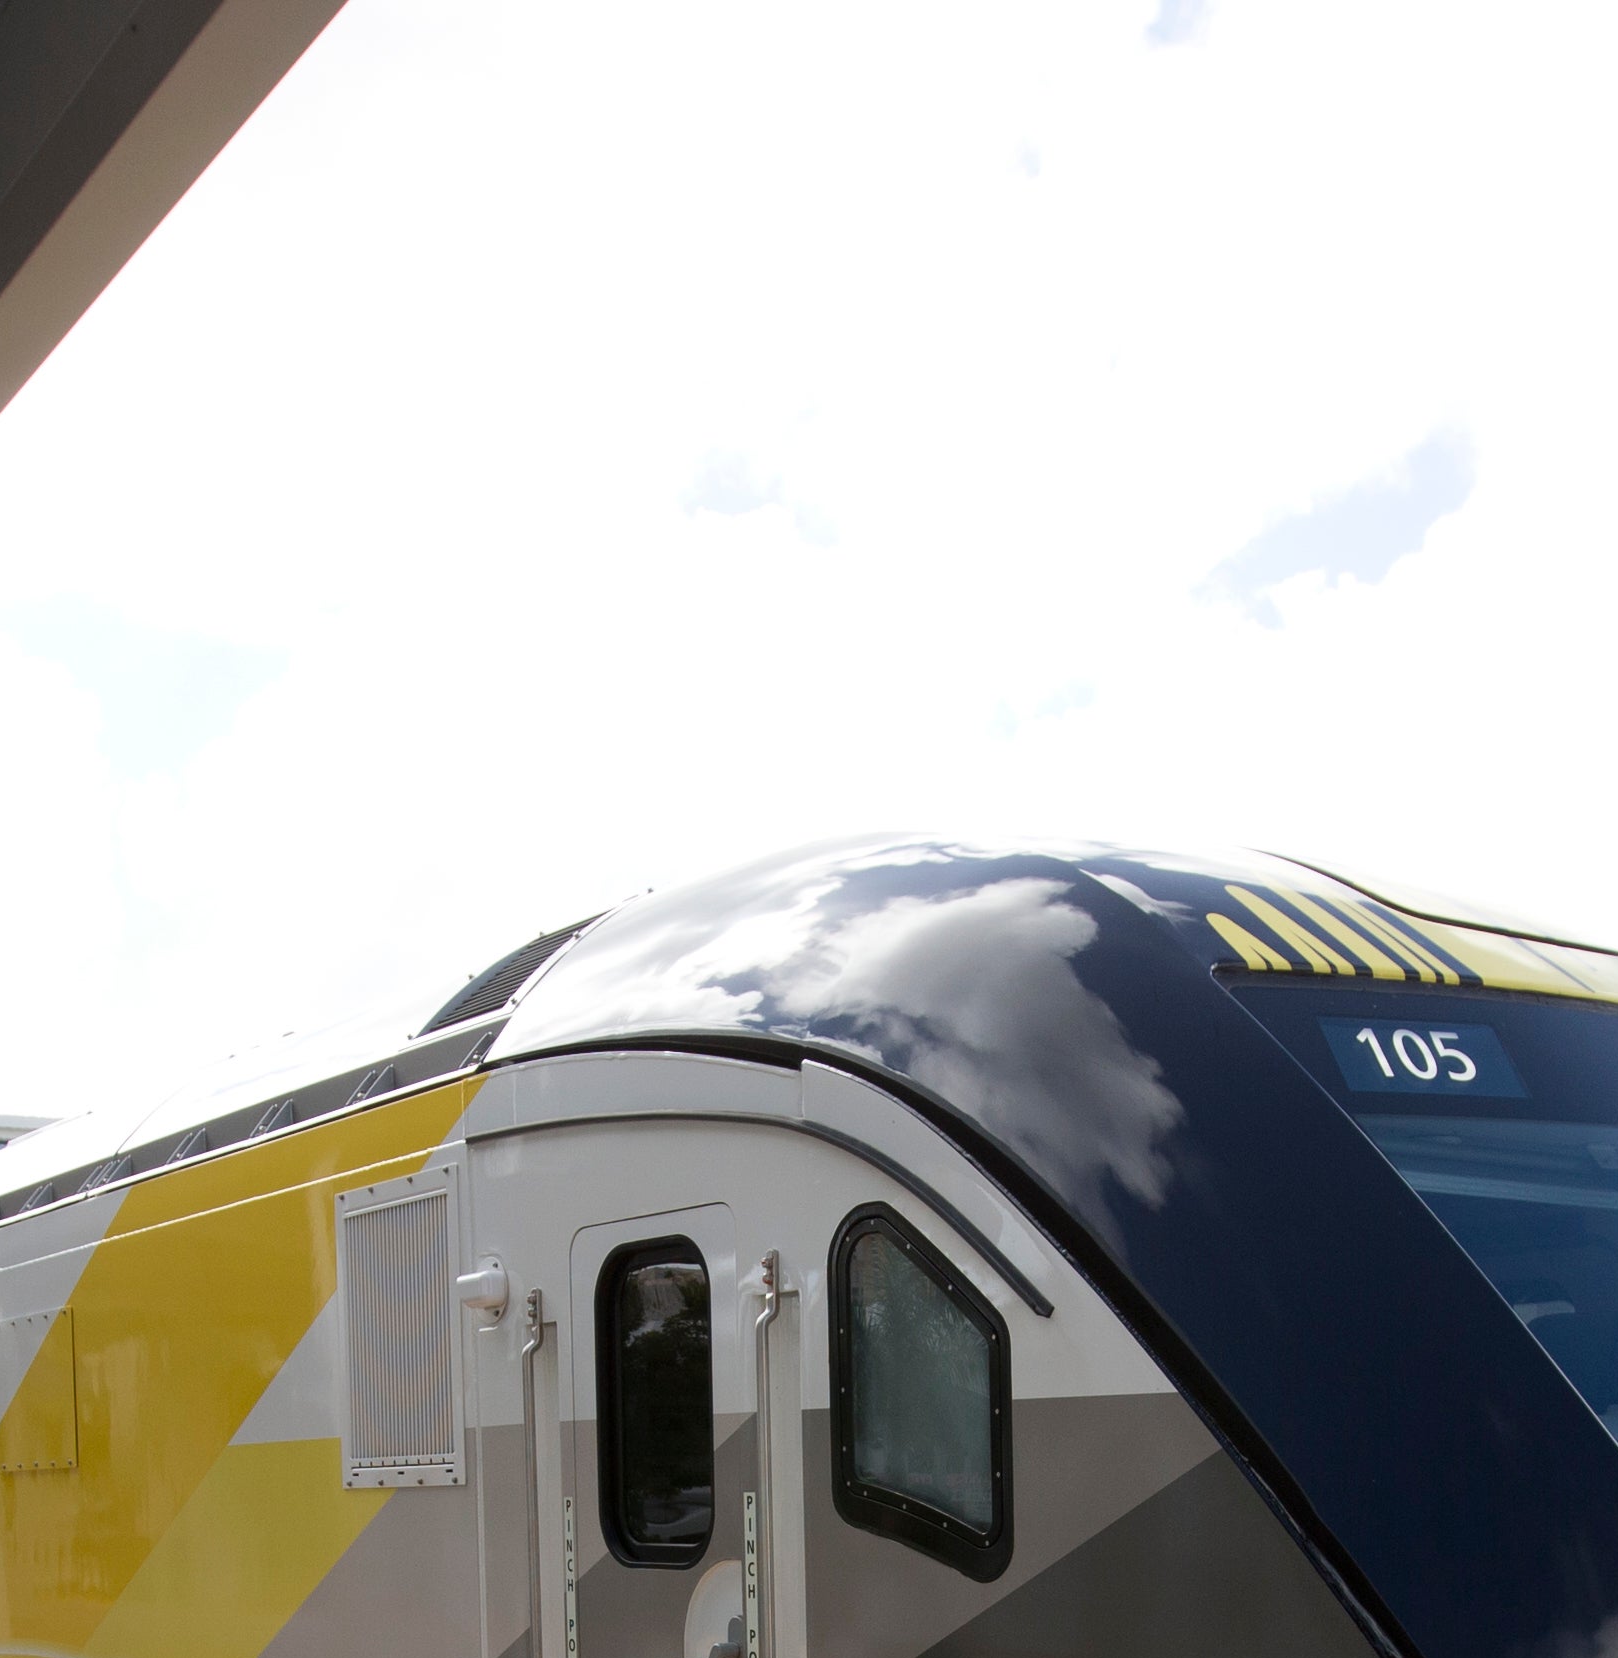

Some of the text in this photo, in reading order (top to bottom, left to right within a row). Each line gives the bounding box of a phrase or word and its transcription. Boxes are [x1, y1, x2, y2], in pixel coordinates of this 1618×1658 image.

[1355, 1027, 1477, 1082] 105
[566, 1499, 574, 1592] PINCH
[747, 1495, 756, 1599] PINCH
